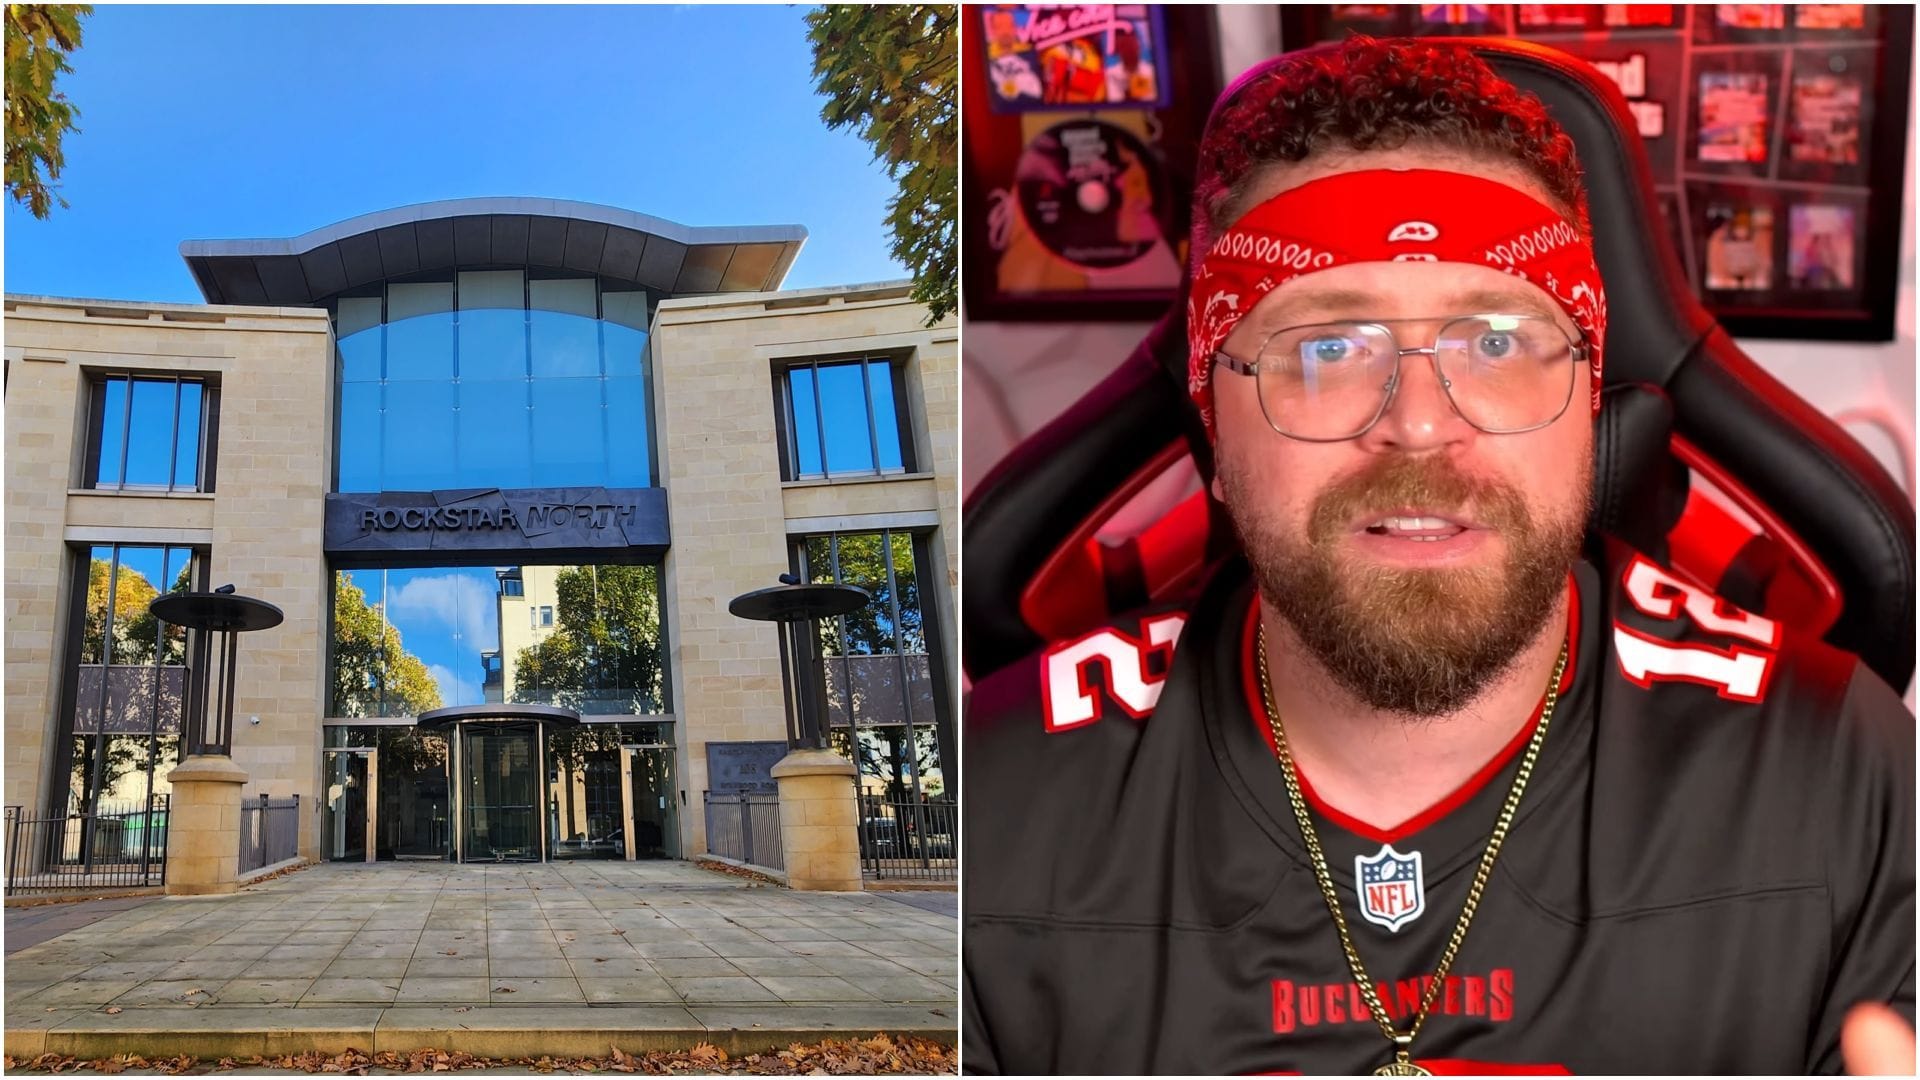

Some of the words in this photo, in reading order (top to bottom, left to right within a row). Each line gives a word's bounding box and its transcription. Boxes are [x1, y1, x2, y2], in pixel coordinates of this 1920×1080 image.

[360, 506, 517, 531] ROCKSTAR
[526, 503, 637, 530] NORTH
[1367, 883, 1415, 916] NFL
